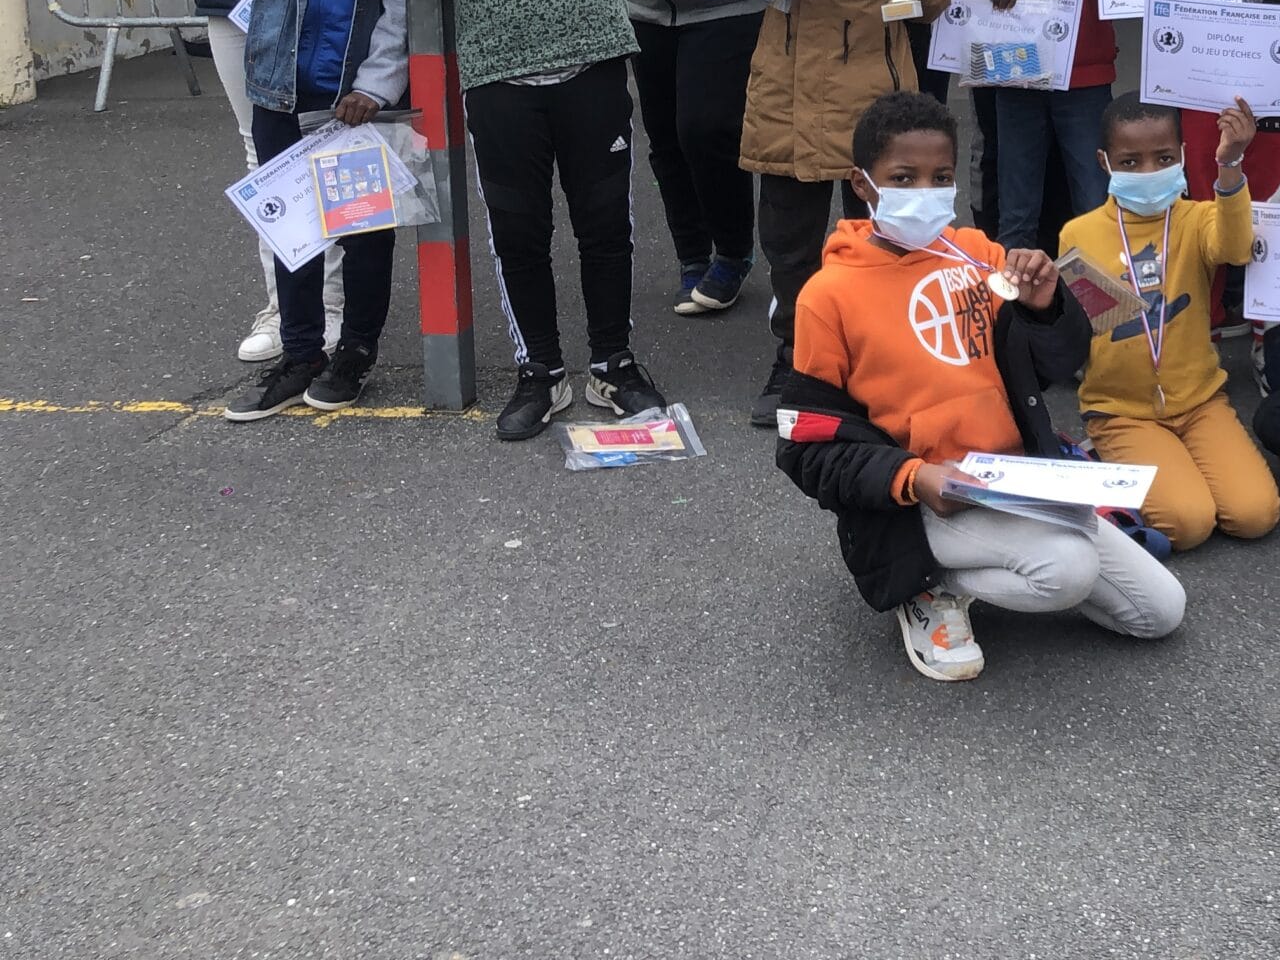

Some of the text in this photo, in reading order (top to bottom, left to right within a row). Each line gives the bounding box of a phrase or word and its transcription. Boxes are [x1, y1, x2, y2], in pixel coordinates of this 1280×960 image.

[1154, 3, 1170, 17] ffe
[1174, 3, 1218, 17] FÉDÉRATION
[1220, 8, 1261, 21] FRANÇAISE
[1262, 13, 1277, 21] DES
[1206, 32, 1245, 44] DIPLÔME
[1191, 46, 1262, 60] DU JEU D'ÉCHECS
[254, 161, 291, 187] FÉDÉRATION
[289, 138, 322, 162] FRANÇAISE
[239, 185, 257, 200] ffe
[291, 193, 305, 204] DU
